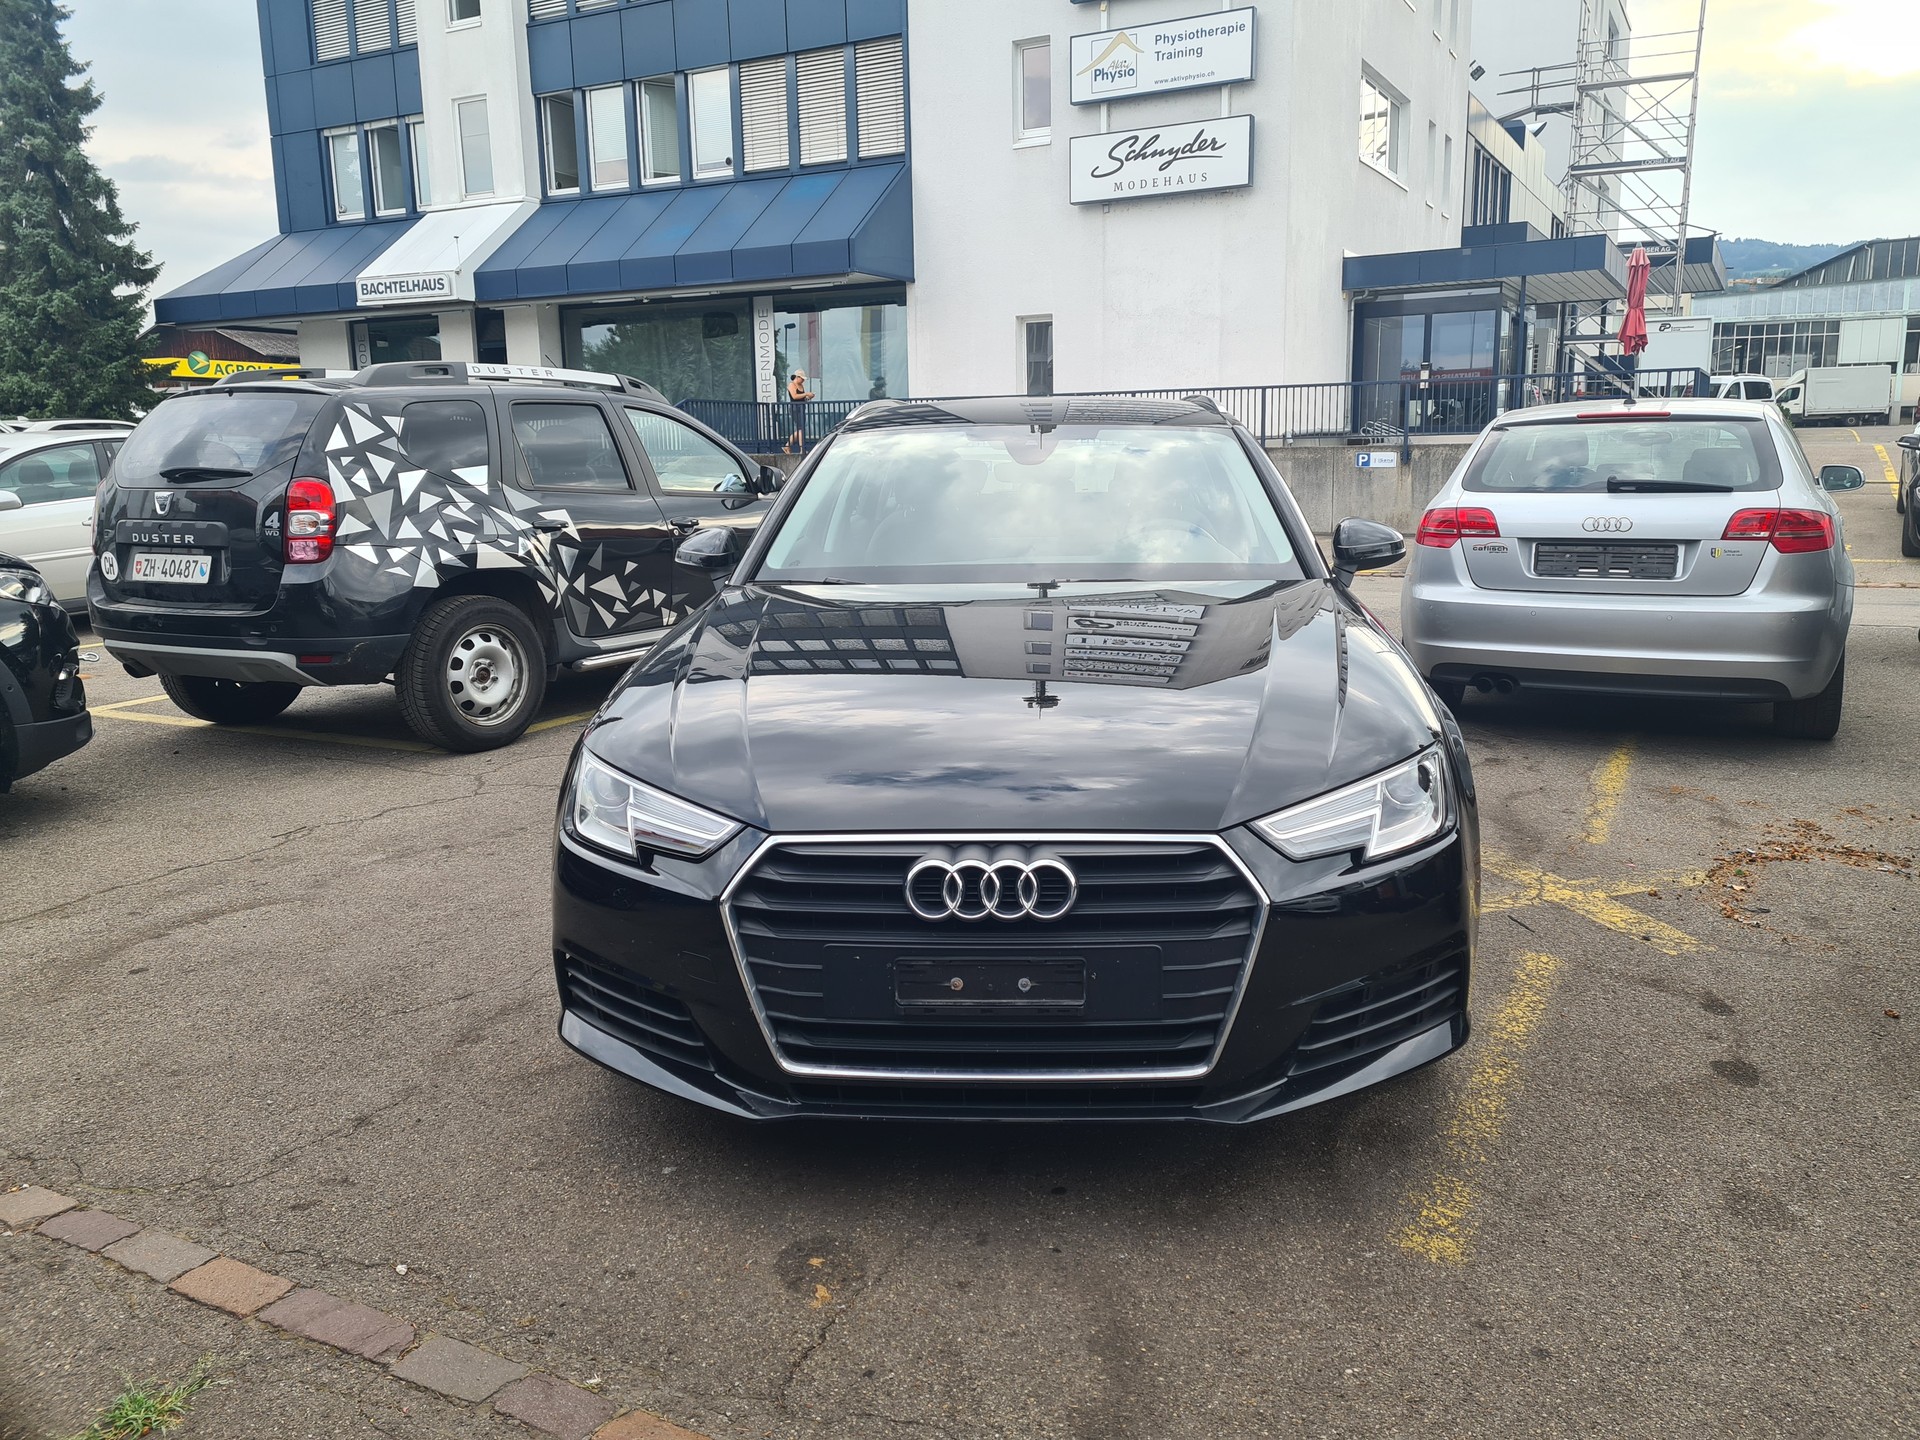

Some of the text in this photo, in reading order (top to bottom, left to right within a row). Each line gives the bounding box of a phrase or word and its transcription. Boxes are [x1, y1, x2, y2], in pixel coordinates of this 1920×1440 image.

[1154, 21, 1246, 46] Physiotherapie
[1154, 45, 1203, 62] Training
[1093, 66, 1136, 84] Physio
[1154, 70, 1215, 85] www.aktivphysio.ch
[1090, 128, 1227, 178] Schnyder
[1113, 172, 1208, 192] MODEHAUS
[360, 277, 445, 296] BACHTELHAUS
[472, 365, 554, 377] DUSTER
[264, 511, 280, 529] 4
[132, 533, 195, 544] DUSTER
[264, 529, 280, 537] WD
[103, 555, 114, 575] CH
